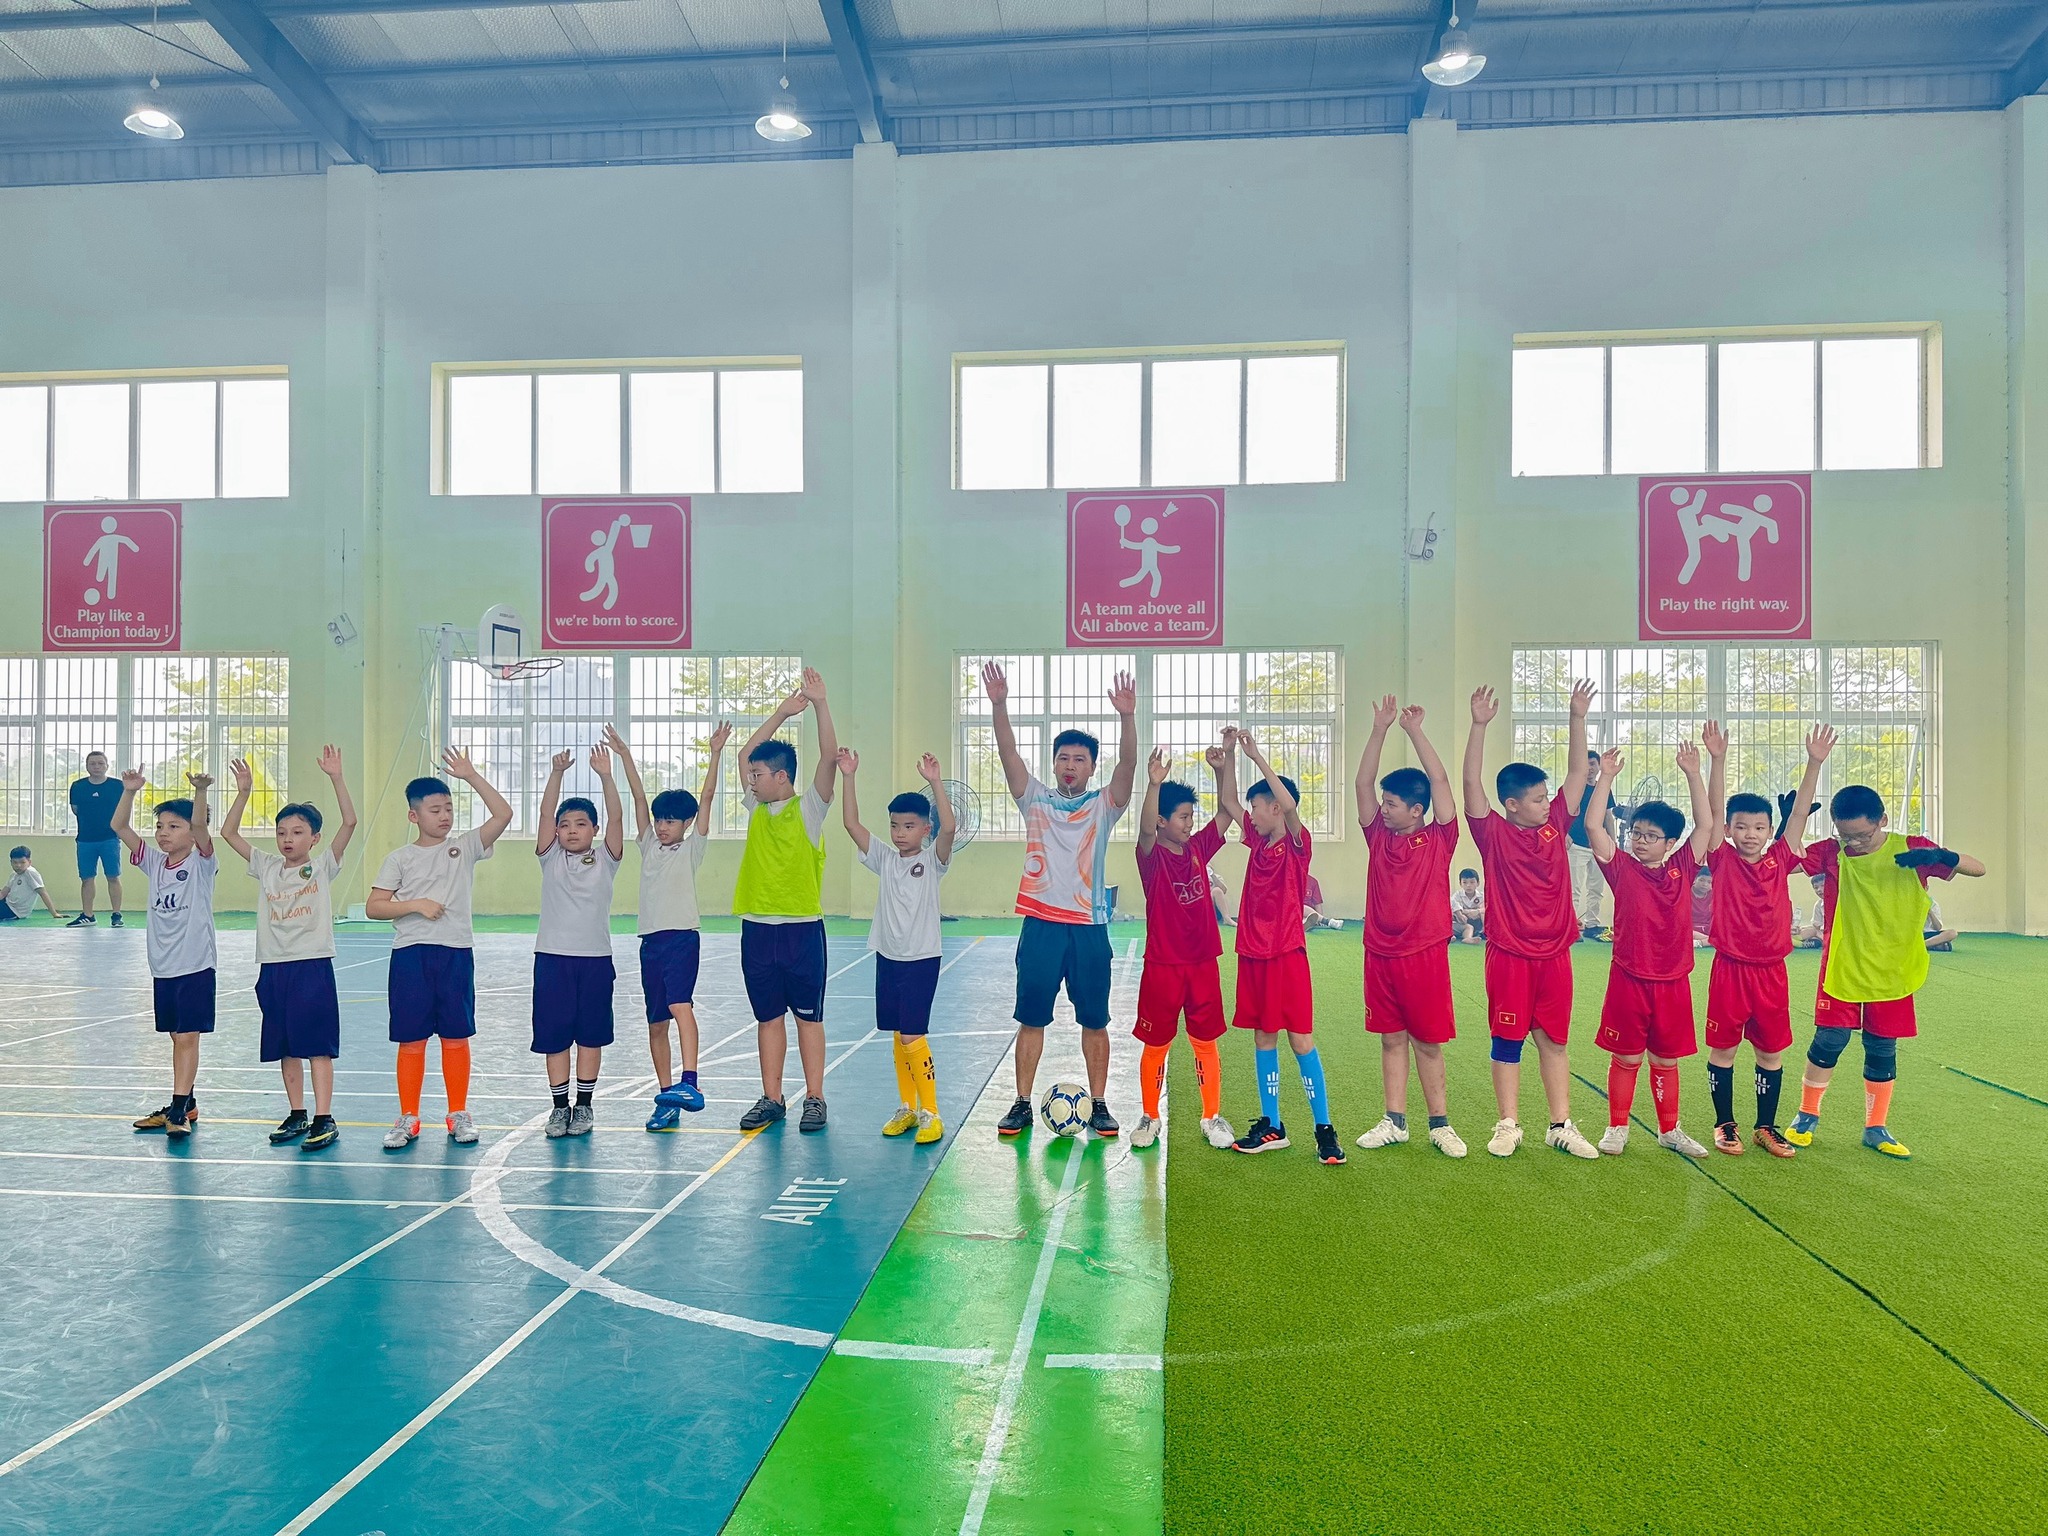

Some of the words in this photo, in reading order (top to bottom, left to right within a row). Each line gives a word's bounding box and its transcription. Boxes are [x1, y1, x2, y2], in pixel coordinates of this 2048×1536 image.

[1080, 602, 1092, 616] A
[1095, 603, 1133, 615] team
[1138, 601, 1182, 615] above
[1187, 600, 1206, 614] all
[1659, 598, 1690, 613] Play
[1694, 597, 1717, 610] the
[1721, 597, 1755, 613] right
[1759, 599, 1790, 612] way.
[77, 609, 105, 625] Play
[109, 609, 133, 622] like
[137, 612, 145, 622] a
[555, 614, 589, 626] we're
[592, 614, 621, 626] born
[625, 615, 637, 626] to
[641, 616, 678, 626] score.
[54, 625, 120, 640] Champion
[125, 624, 161, 640] today
[1080, 619, 1100, 632] All
[1105, 619, 1149, 632] above
[1154, 621, 1163, 632] a
[1168, 619, 1210, 632] team.
[282, 905, 312, 920] Learn
[760, 1176, 848, 1226] ALITE
